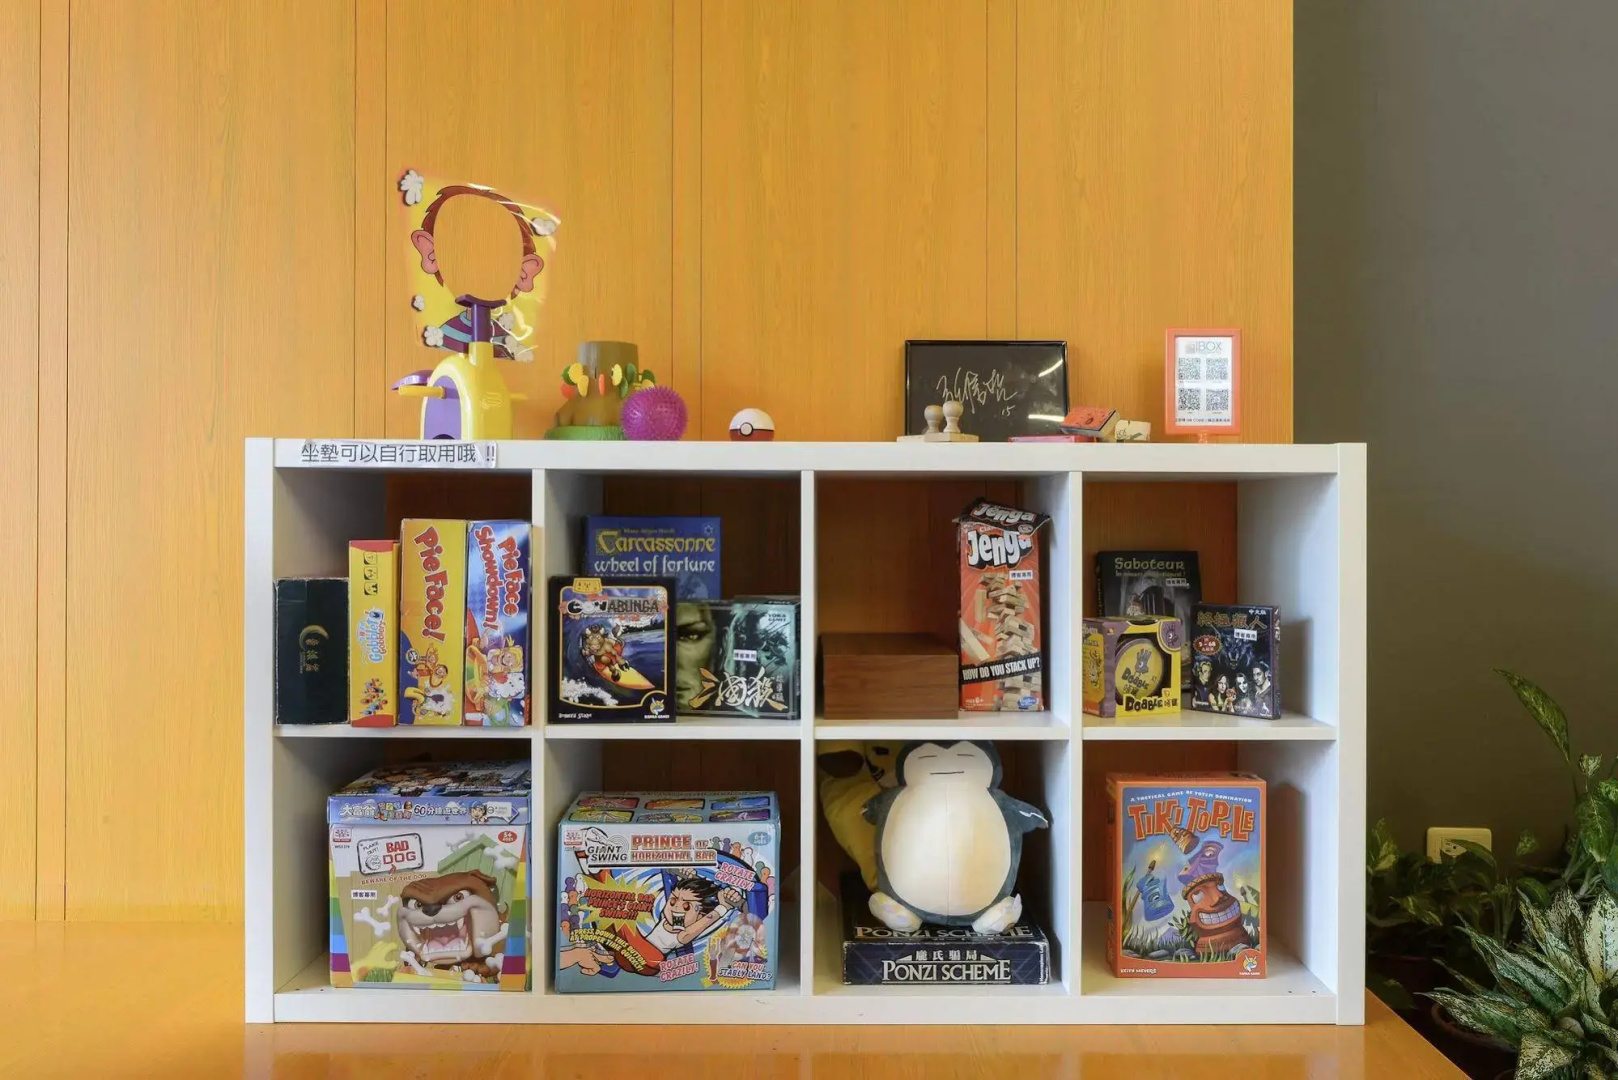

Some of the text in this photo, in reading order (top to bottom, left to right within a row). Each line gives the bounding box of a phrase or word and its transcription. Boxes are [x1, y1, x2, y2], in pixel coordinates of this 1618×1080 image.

[301, 444, 476, 463] 坐墊可以自行取用哦
[973, 503, 1035, 523] Jenga
[597, 530, 716, 554] Carcassonne
[968, 530, 1032, 566] Jenga
[594, 554, 715, 573] wheel of fortune
[1114, 557, 1185, 570] Saboteur
[414, 525, 449, 642] Pie Face!
[474, 525, 504, 631] Showdown!
[498, 536, 524, 617] Pie Face
[962, 657, 1041, 681] HOW DO YOU STACK UP?
[1136, 793, 1165, 801] TACTICAL
[1215, 794, 1253, 803] DOMINATION
[340, 804, 375, 817] 大富翁
[1127, 796, 1255, 841] TIKI TOPPLE
[386, 840, 410, 853] BAD
[587, 846, 622, 854] GIANT
[631, 834, 708, 850] PRINCE OF
[383, 851, 417, 865] DOG
[591, 854, 628, 862] SWING
[631, 851, 716, 862] HORIZONTAL BAR
[721, 861, 755, 880] ROTATE
[715, 871, 755, 892] CRAZILY!
[584, 889, 655, 903] HORIZONTAL BAR
[587, 899, 654, 912] PRINCE'S GIANT
[599, 909, 639, 920] SWING!!!
[574, 928, 647, 967] PRESS DOWN THIS BUTTON
[580, 934, 606, 945] PROPER
[605, 939, 622, 951] TIME
[620, 949, 644, 972] QUICKLY!
[659, 953, 694, 972] ROTATE
[660, 962, 700, 982] CRAZILY!
[732, 961, 766, 972] CAN YOU
[881, 959, 1012, 981] PONZI SCHEME
[718, 967, 773, 981] STABLY LAND?
